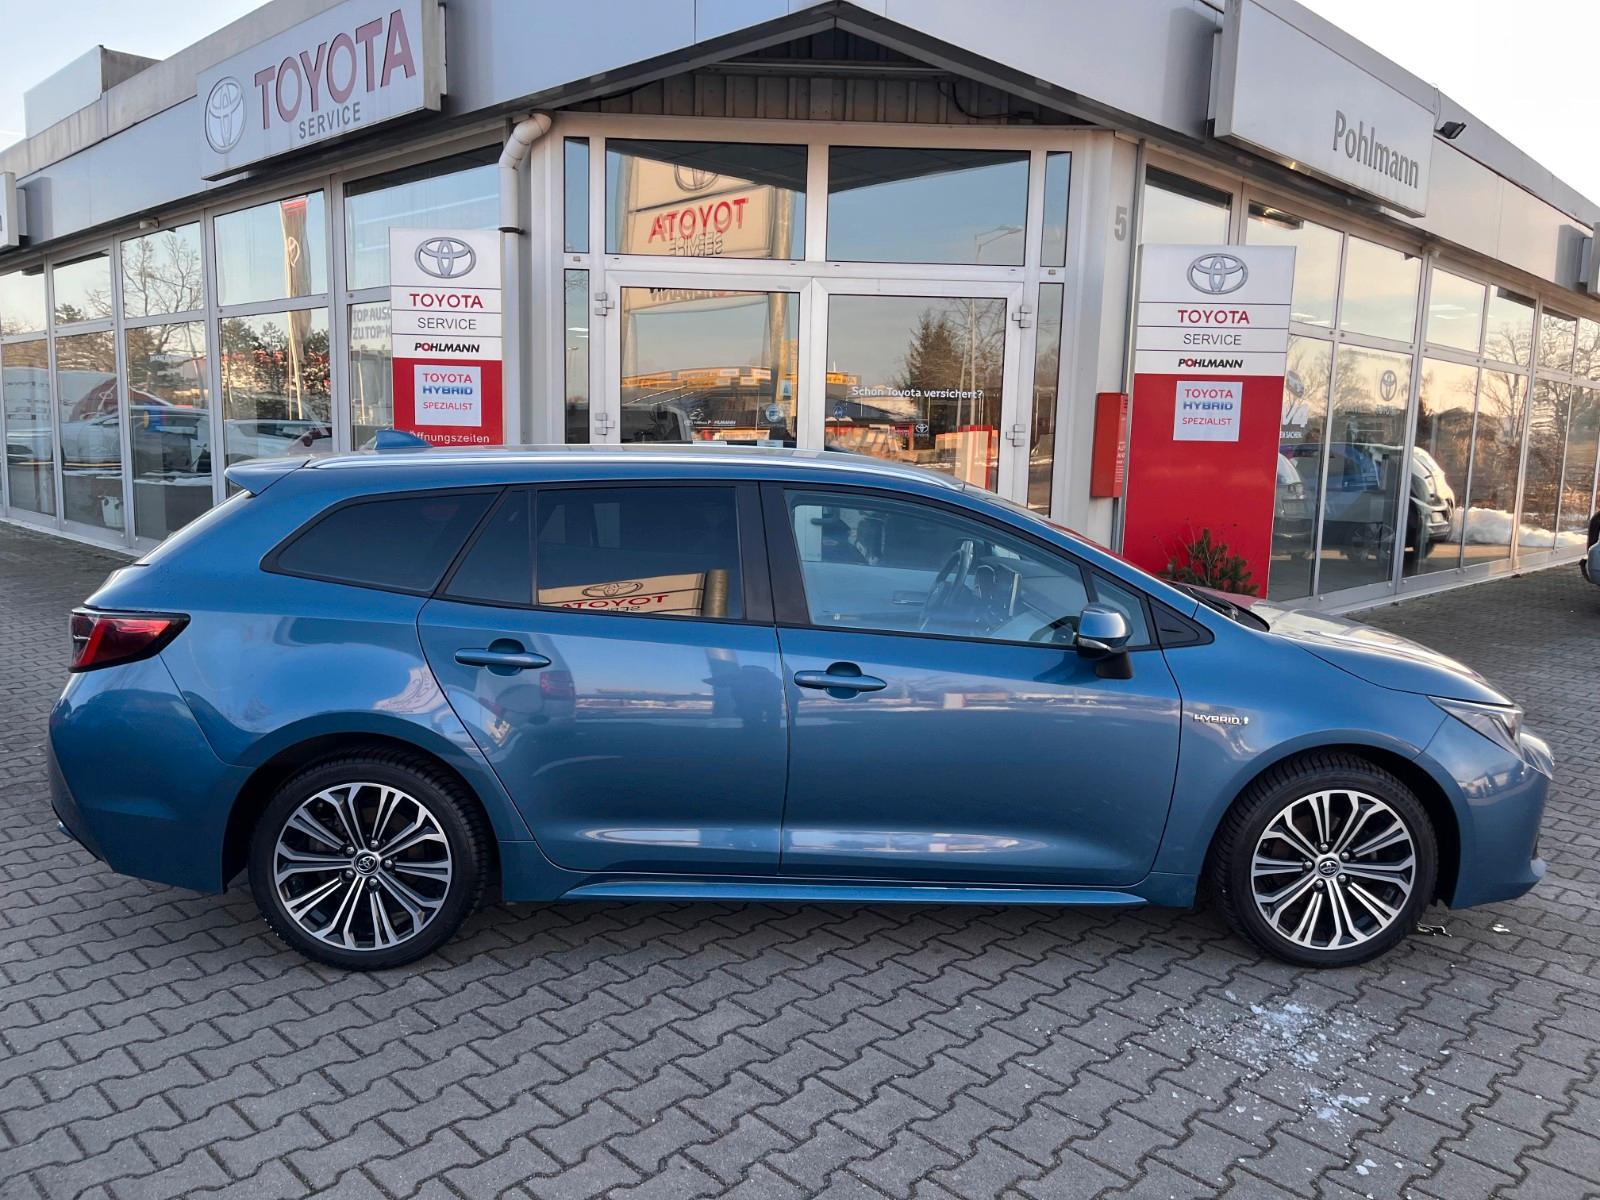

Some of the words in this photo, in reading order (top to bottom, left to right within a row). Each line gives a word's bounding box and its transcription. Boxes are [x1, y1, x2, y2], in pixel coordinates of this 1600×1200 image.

[254, 8, 417, 131] TOYOTA
[299, 101, 361, 140] SERVICE
[1332, 109, 1419, 190] Pohlmann
[1114, 205, 1128, 242] 5
[409, 293, 484, 309] TOYOTA
[1177, 309, 1250, 324] TOYOTA
[417, 317, 477, 330] SERVICE
[1183, 333, 1242, 346] SERVICE
[414, 342, 480, 353] POHLMANN
[1178, 358, 1244, 369] POHLMANN
[422, 373, 473, 384] TOYOTA
[422, 386, 473, 396] HYBRID
[851, 386, 884, 397] Schon
[887, 387, 921, 398] Toyota
[923, 389, 983, 400] versichert?
[1184, 388, 1234, 399] TOYOTA
[423, 401, 473, 411] SPEZIALIST
[1183, 401, 1234, 411] HYBRID
[1182, 417, 1233, 426] SPEZIALIST
[1194, 713, 1240, 725] HYBRID
